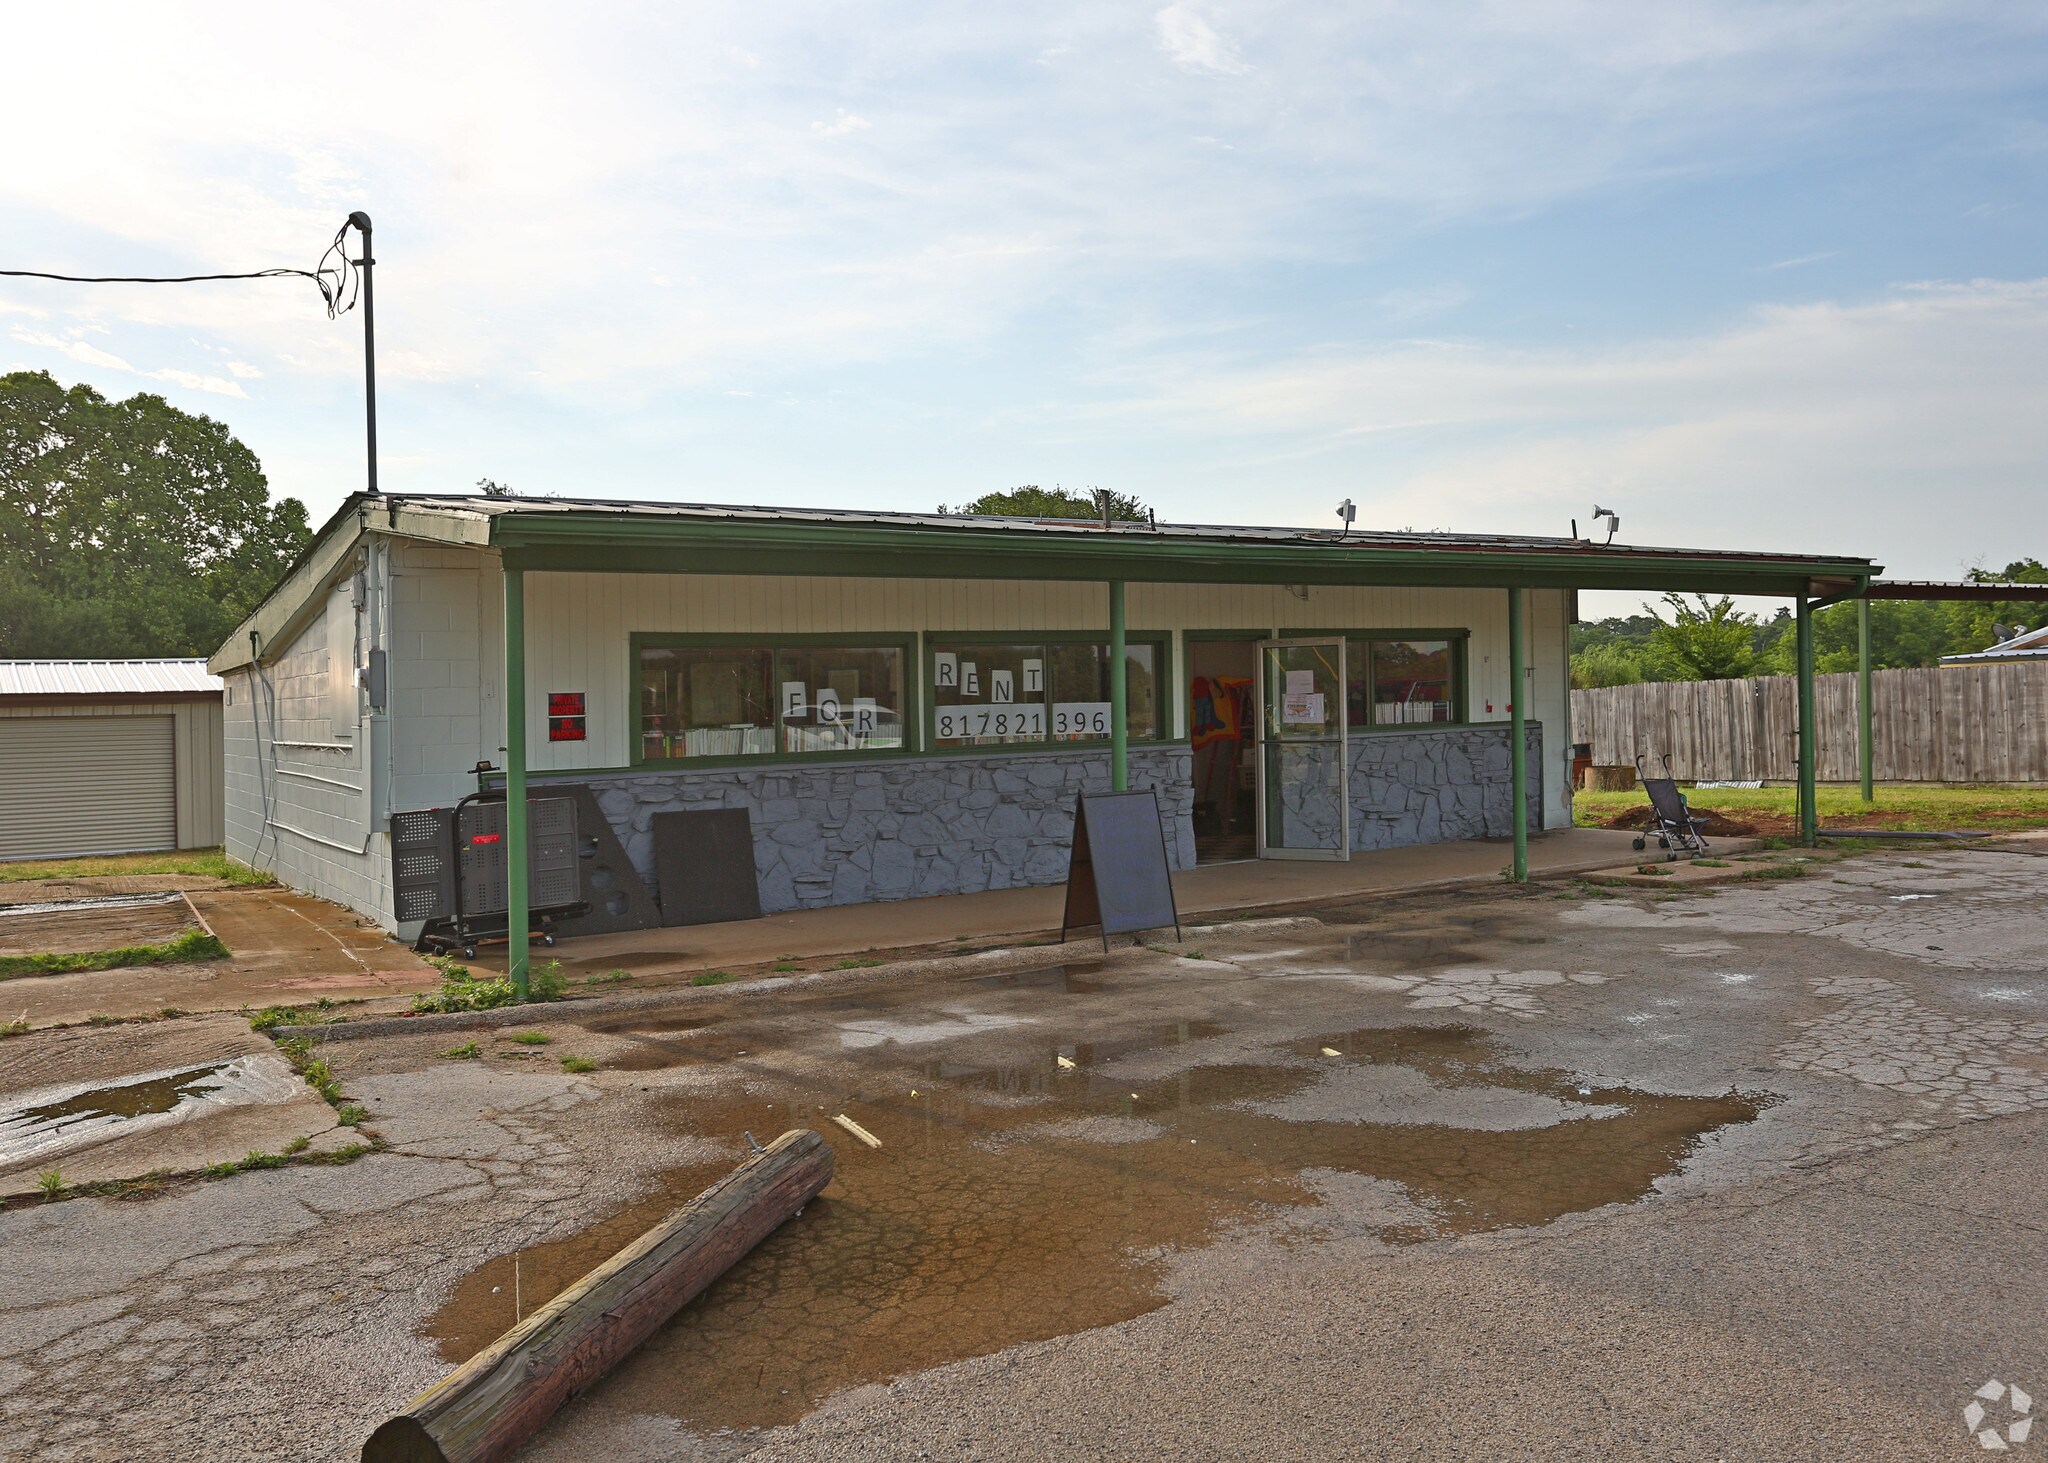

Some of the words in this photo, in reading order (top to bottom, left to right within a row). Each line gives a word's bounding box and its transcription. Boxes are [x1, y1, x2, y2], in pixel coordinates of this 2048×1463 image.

[940, 663, 1040, 701] RENT
[554, 694, 581, 704] PRIVATE
[550, 705, 583, 714] PROPERTY
[789, 692, 873, 731] FOR
[561, 719, 573, 728] NO
[551, 729, 583, 739] PARKING
